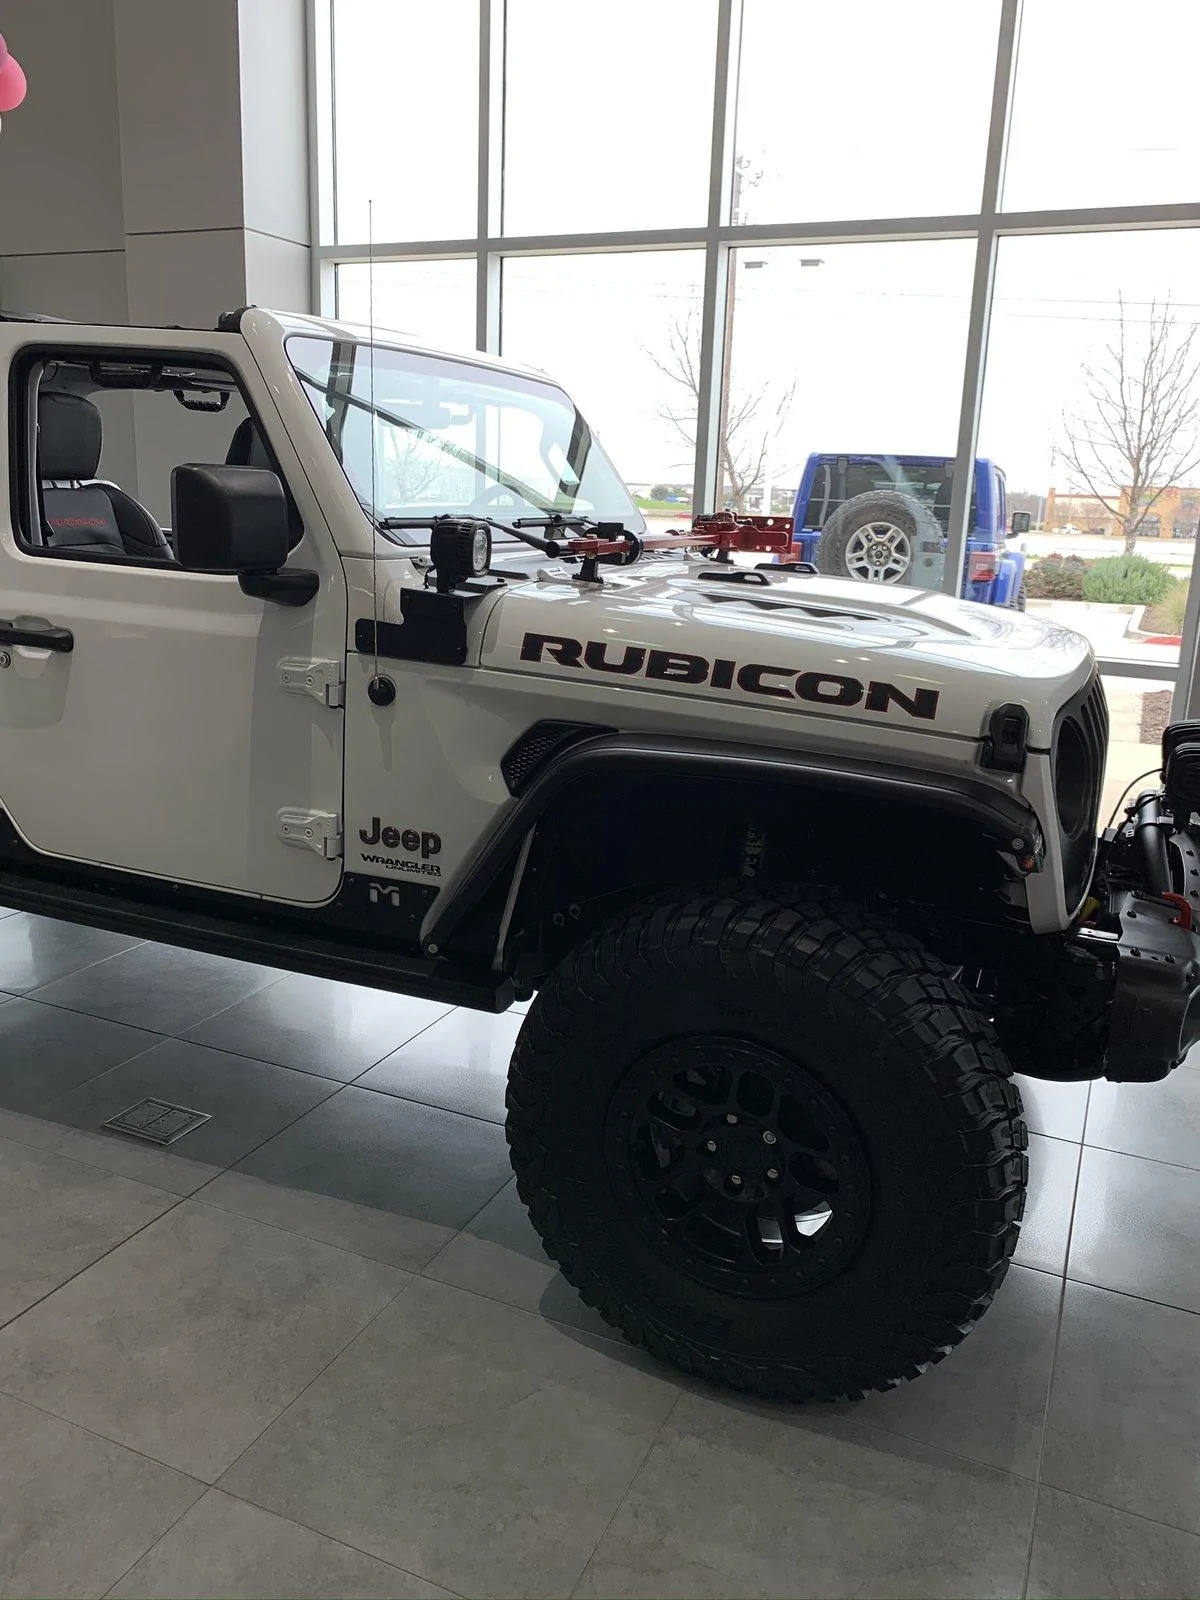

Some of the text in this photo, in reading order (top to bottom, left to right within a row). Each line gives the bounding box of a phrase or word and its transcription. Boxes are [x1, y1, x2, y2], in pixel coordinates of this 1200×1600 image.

[520, 632, 940, 720] RUBICON
[359, 817, 442, 859] Jeep
[360, 853, 441, 873] WRANGLER
[386, 864, 442, 877] UNLIMITED
